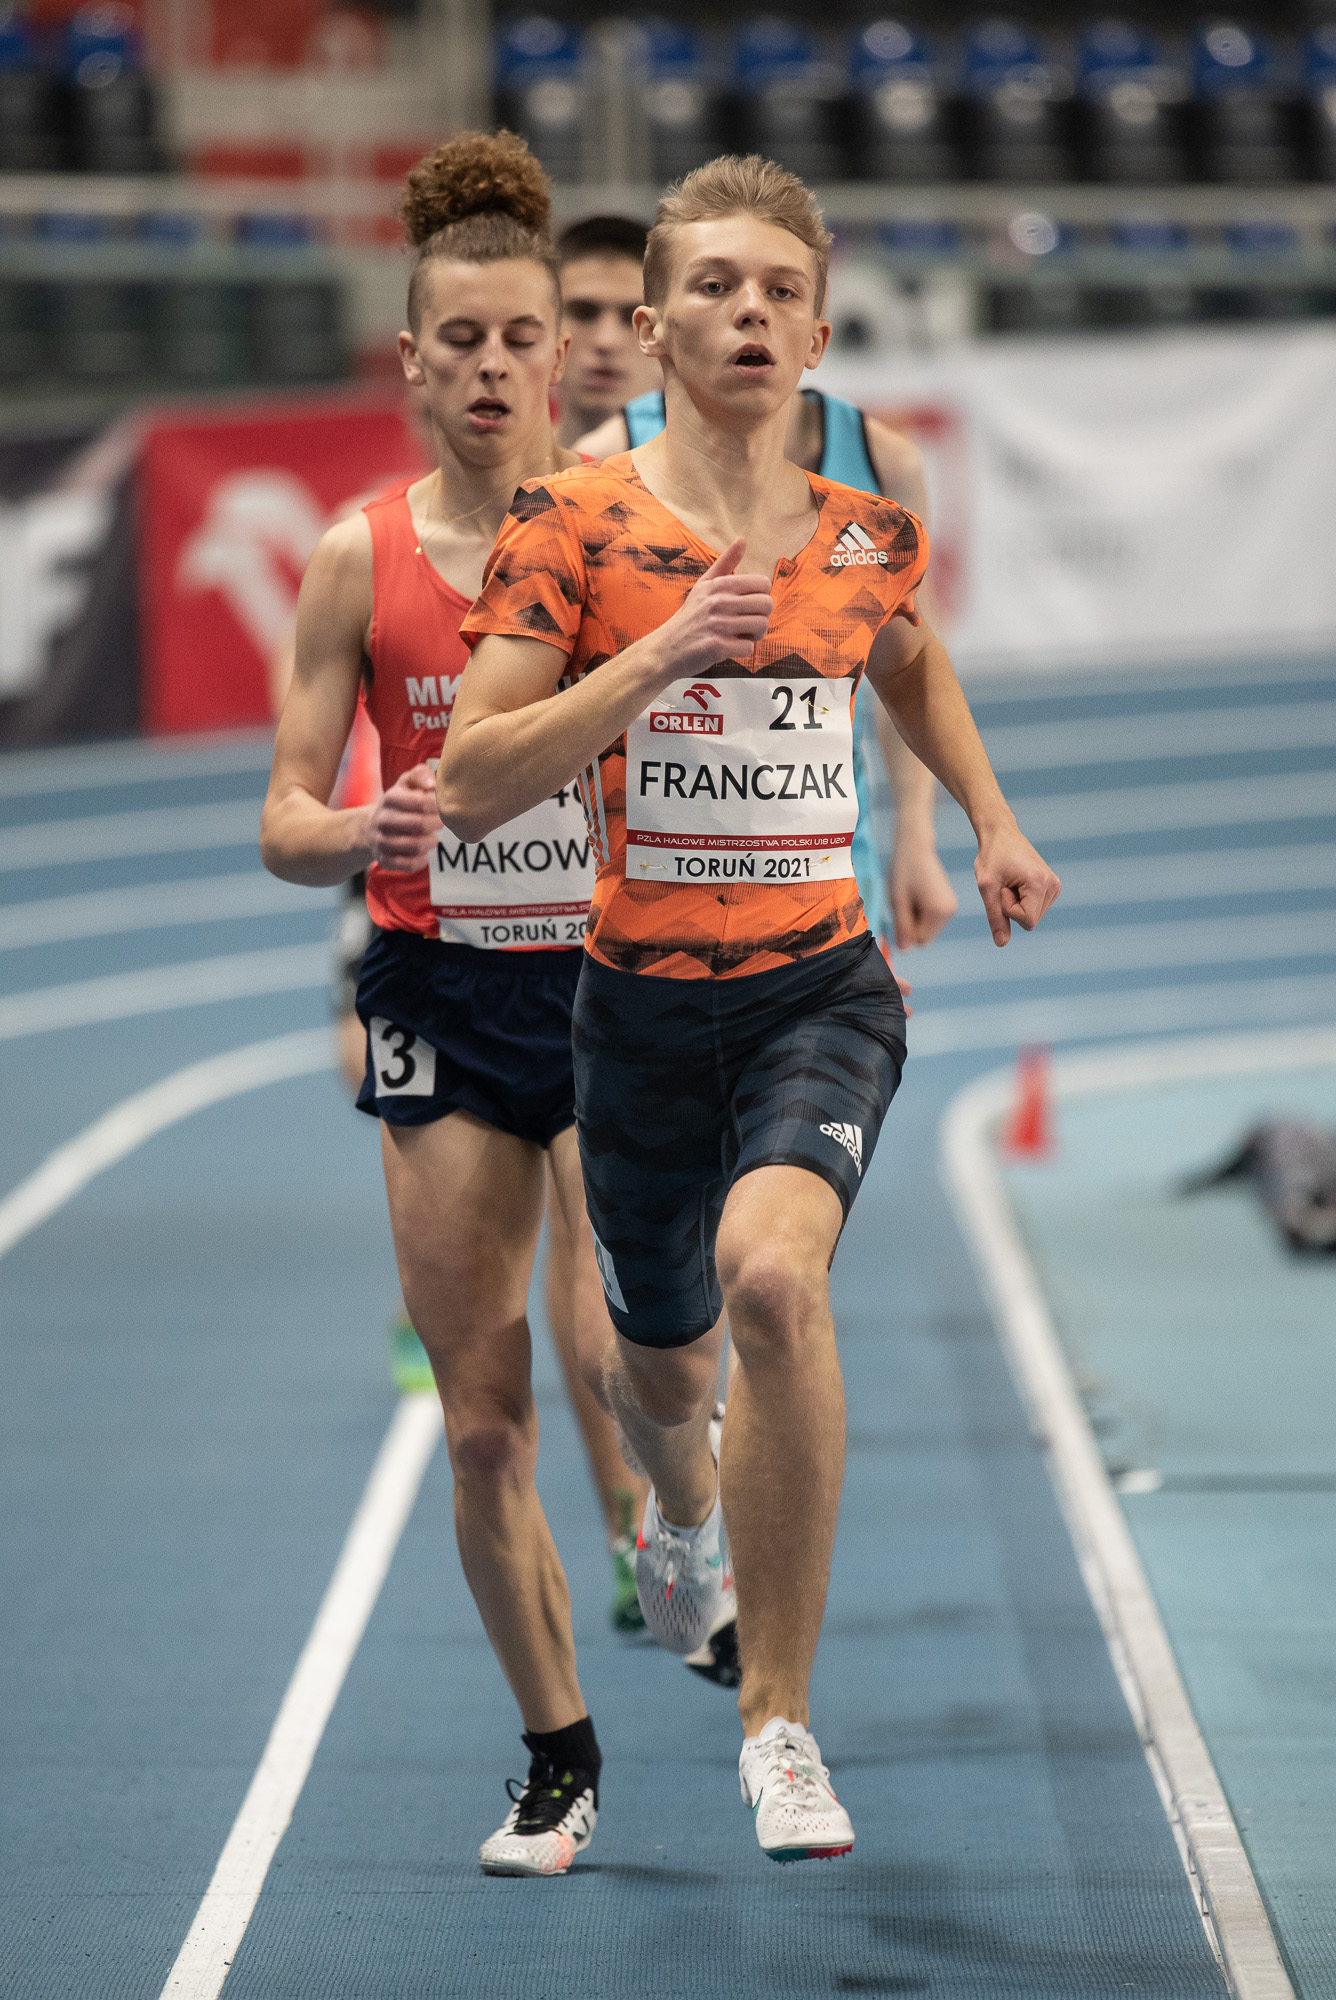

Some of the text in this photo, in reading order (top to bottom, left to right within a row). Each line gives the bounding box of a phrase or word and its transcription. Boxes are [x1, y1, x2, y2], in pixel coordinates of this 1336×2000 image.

[830, 548, 889, 567] adidas
[769, 685, 824, 731] 21
[653, 714, 720, 732] ORLEN
[639, 761, 848, 801] FRANCZAK
[636, 834, 846, 848] PZLA HALOWE MISTRZOSTWA POLSKI U18 U20
[437, 837, 591, 874] MAKOW
[674, 853, 811, 878] TORUŃ 2021
[468, 907, 507, 917] HALOWE
[509, 905, 578, 916] MISTRZOSTWA
[481, 918, 557, 943] TORUŃ
[381, 1023, 417, 1090] 3
